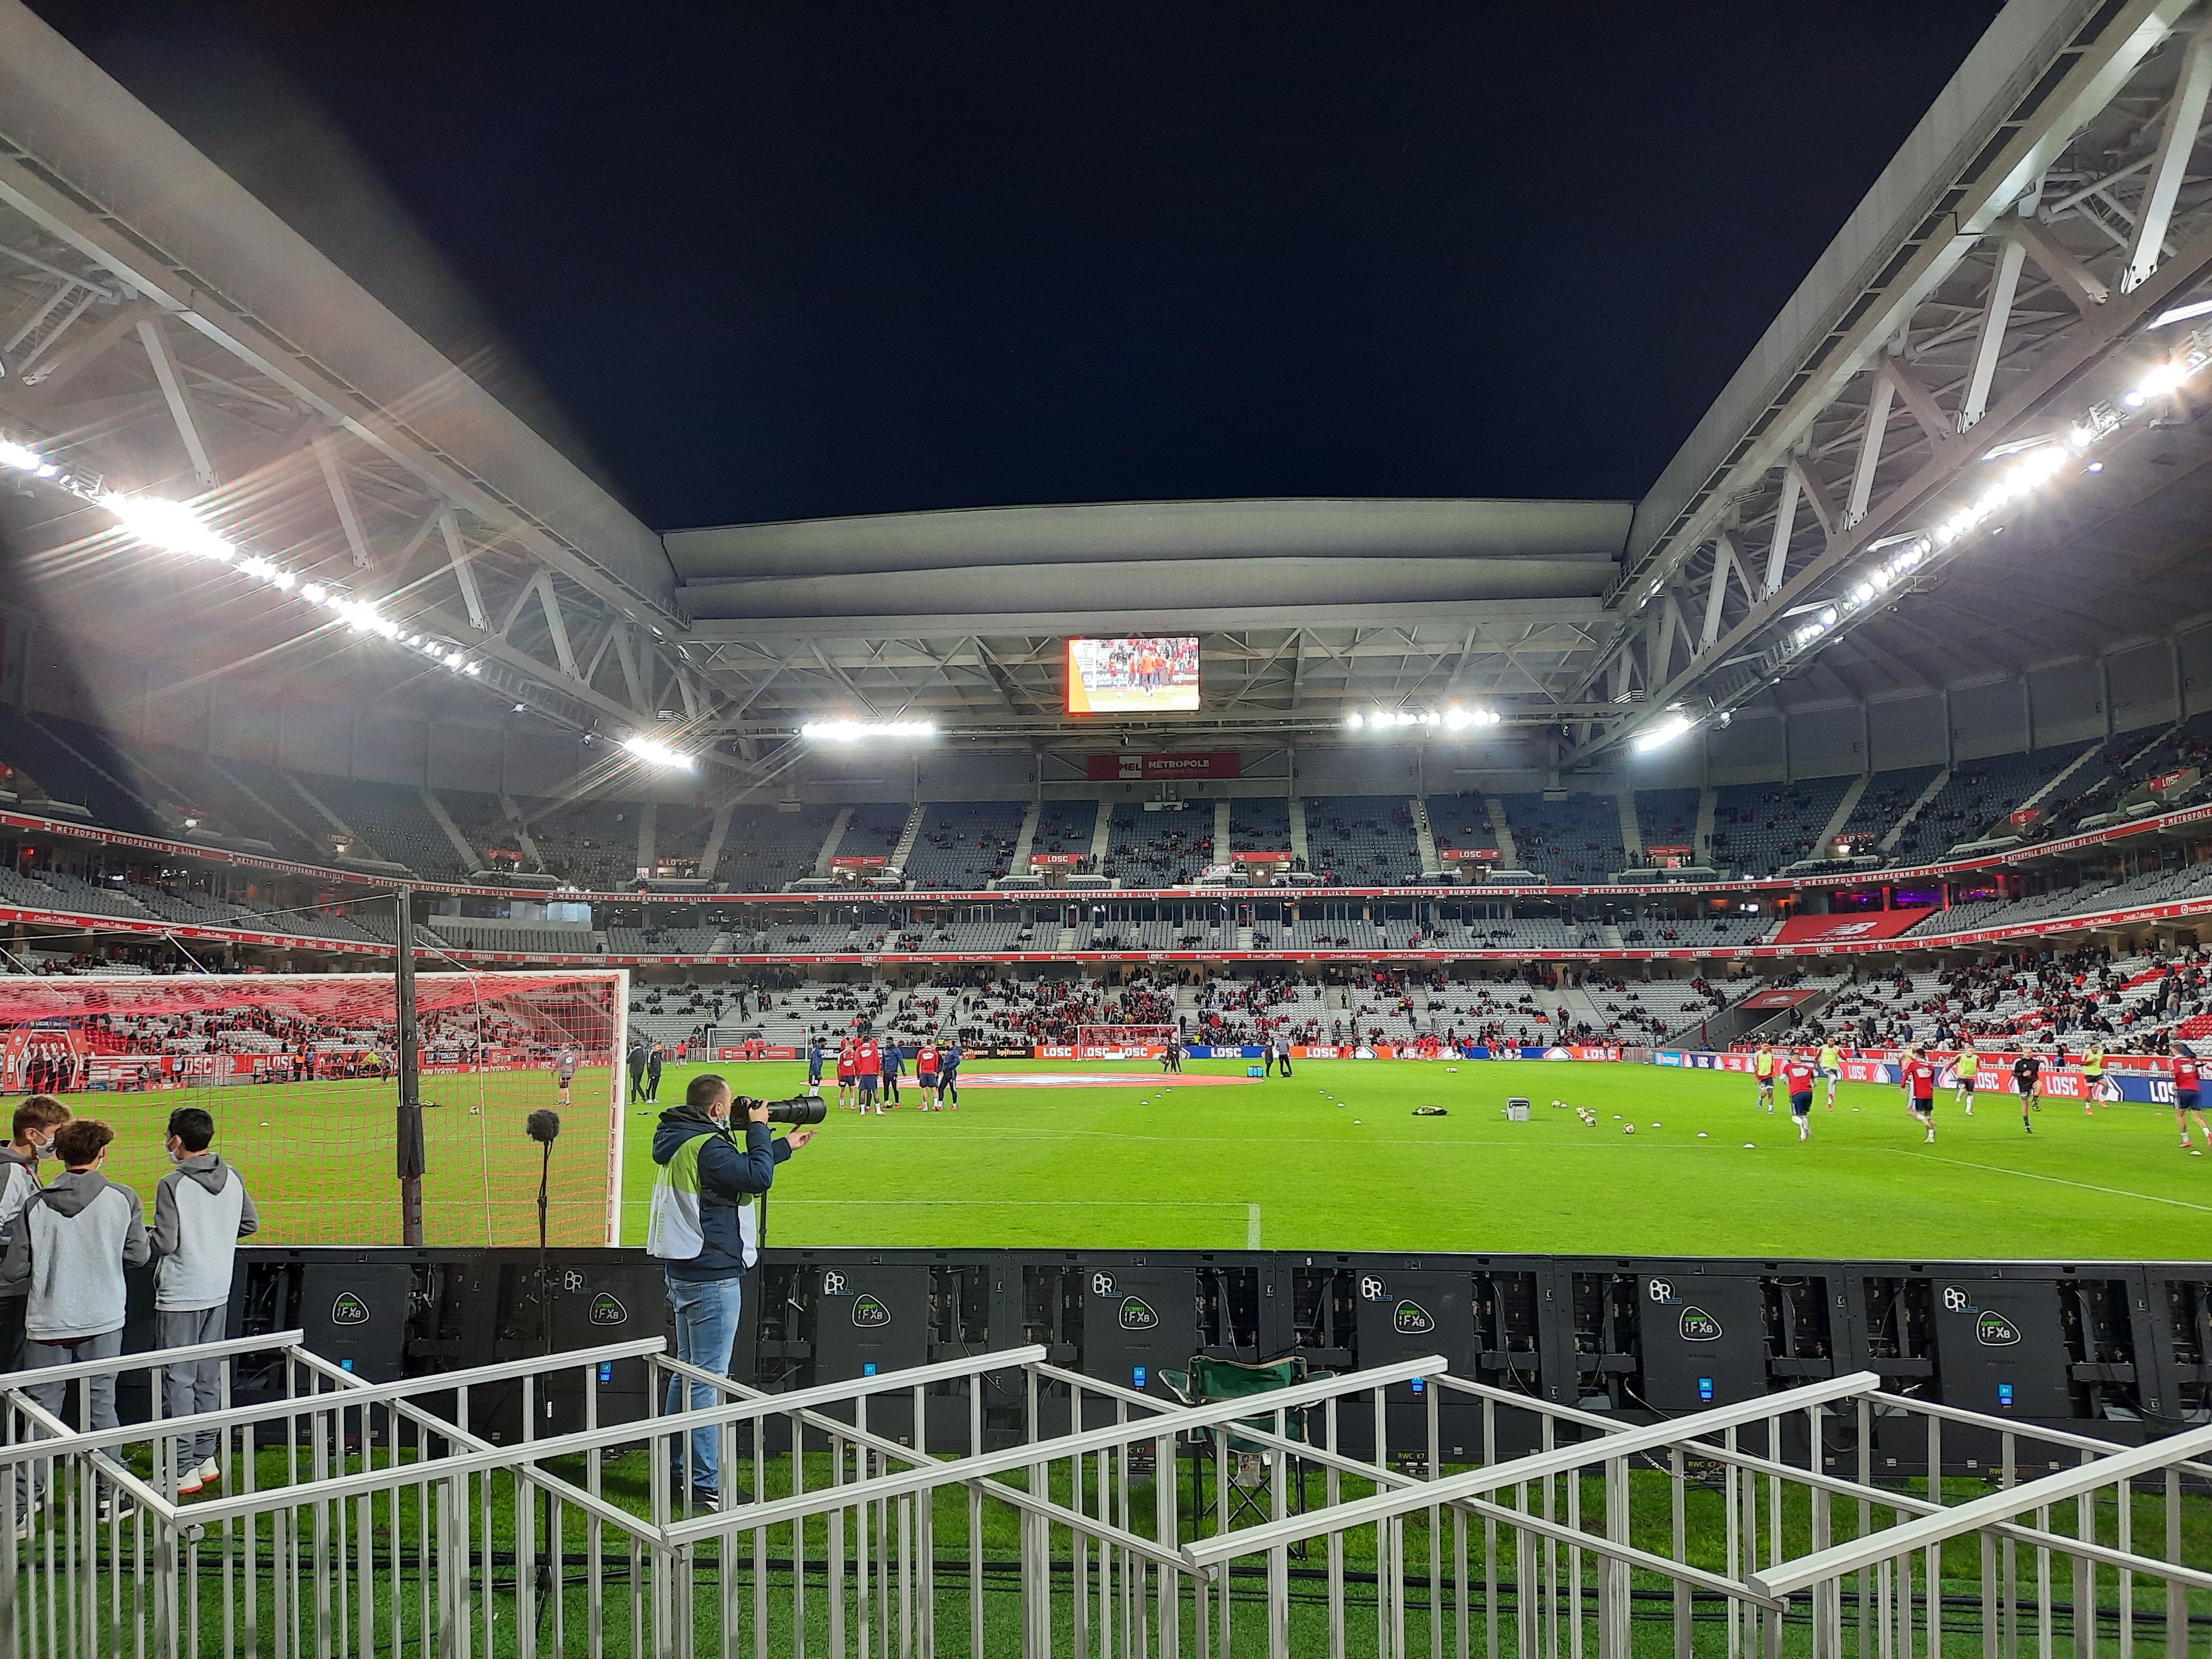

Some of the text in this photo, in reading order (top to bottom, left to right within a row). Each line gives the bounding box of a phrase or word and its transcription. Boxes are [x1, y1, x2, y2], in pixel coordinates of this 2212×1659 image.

[1119, 763, 1142, 771] MEL
[1148, 759, 1209, 769] MÉTROPOLE
[1047, 855, 1068, 863] LOSC
[1459, 850, 1482, 859] LOSC
[962, 1048, 989, 1057] pifrance
[996, 1048, 1026, 1057] bpifrance
[1044, 1047, 1072, 1057] LOSC
[1081, 1048, 1109, 1057] LOSC
[1119, 1047, 1148, 1057] LOSC
[1211, 1047, 1242, 1058] LOSC
[1306, 1048, 1338, 1058] LOSC
[1847, 1065, 1867, 1081] LOSC
[2046, 1076, 2079, 1096] LOSC
[2150, 1081, 2176, 1103] LOS
[564, 1271, 583, 1293] BR
[826, 1271, 844, 1295] BR
[1093, 1274, 1112, 1297] BR
[1361, 1277, 1381, 1301] BR
[1650, 1280, 1671, 1303] BR
[1944, 1288, 1966, 1312] BR
